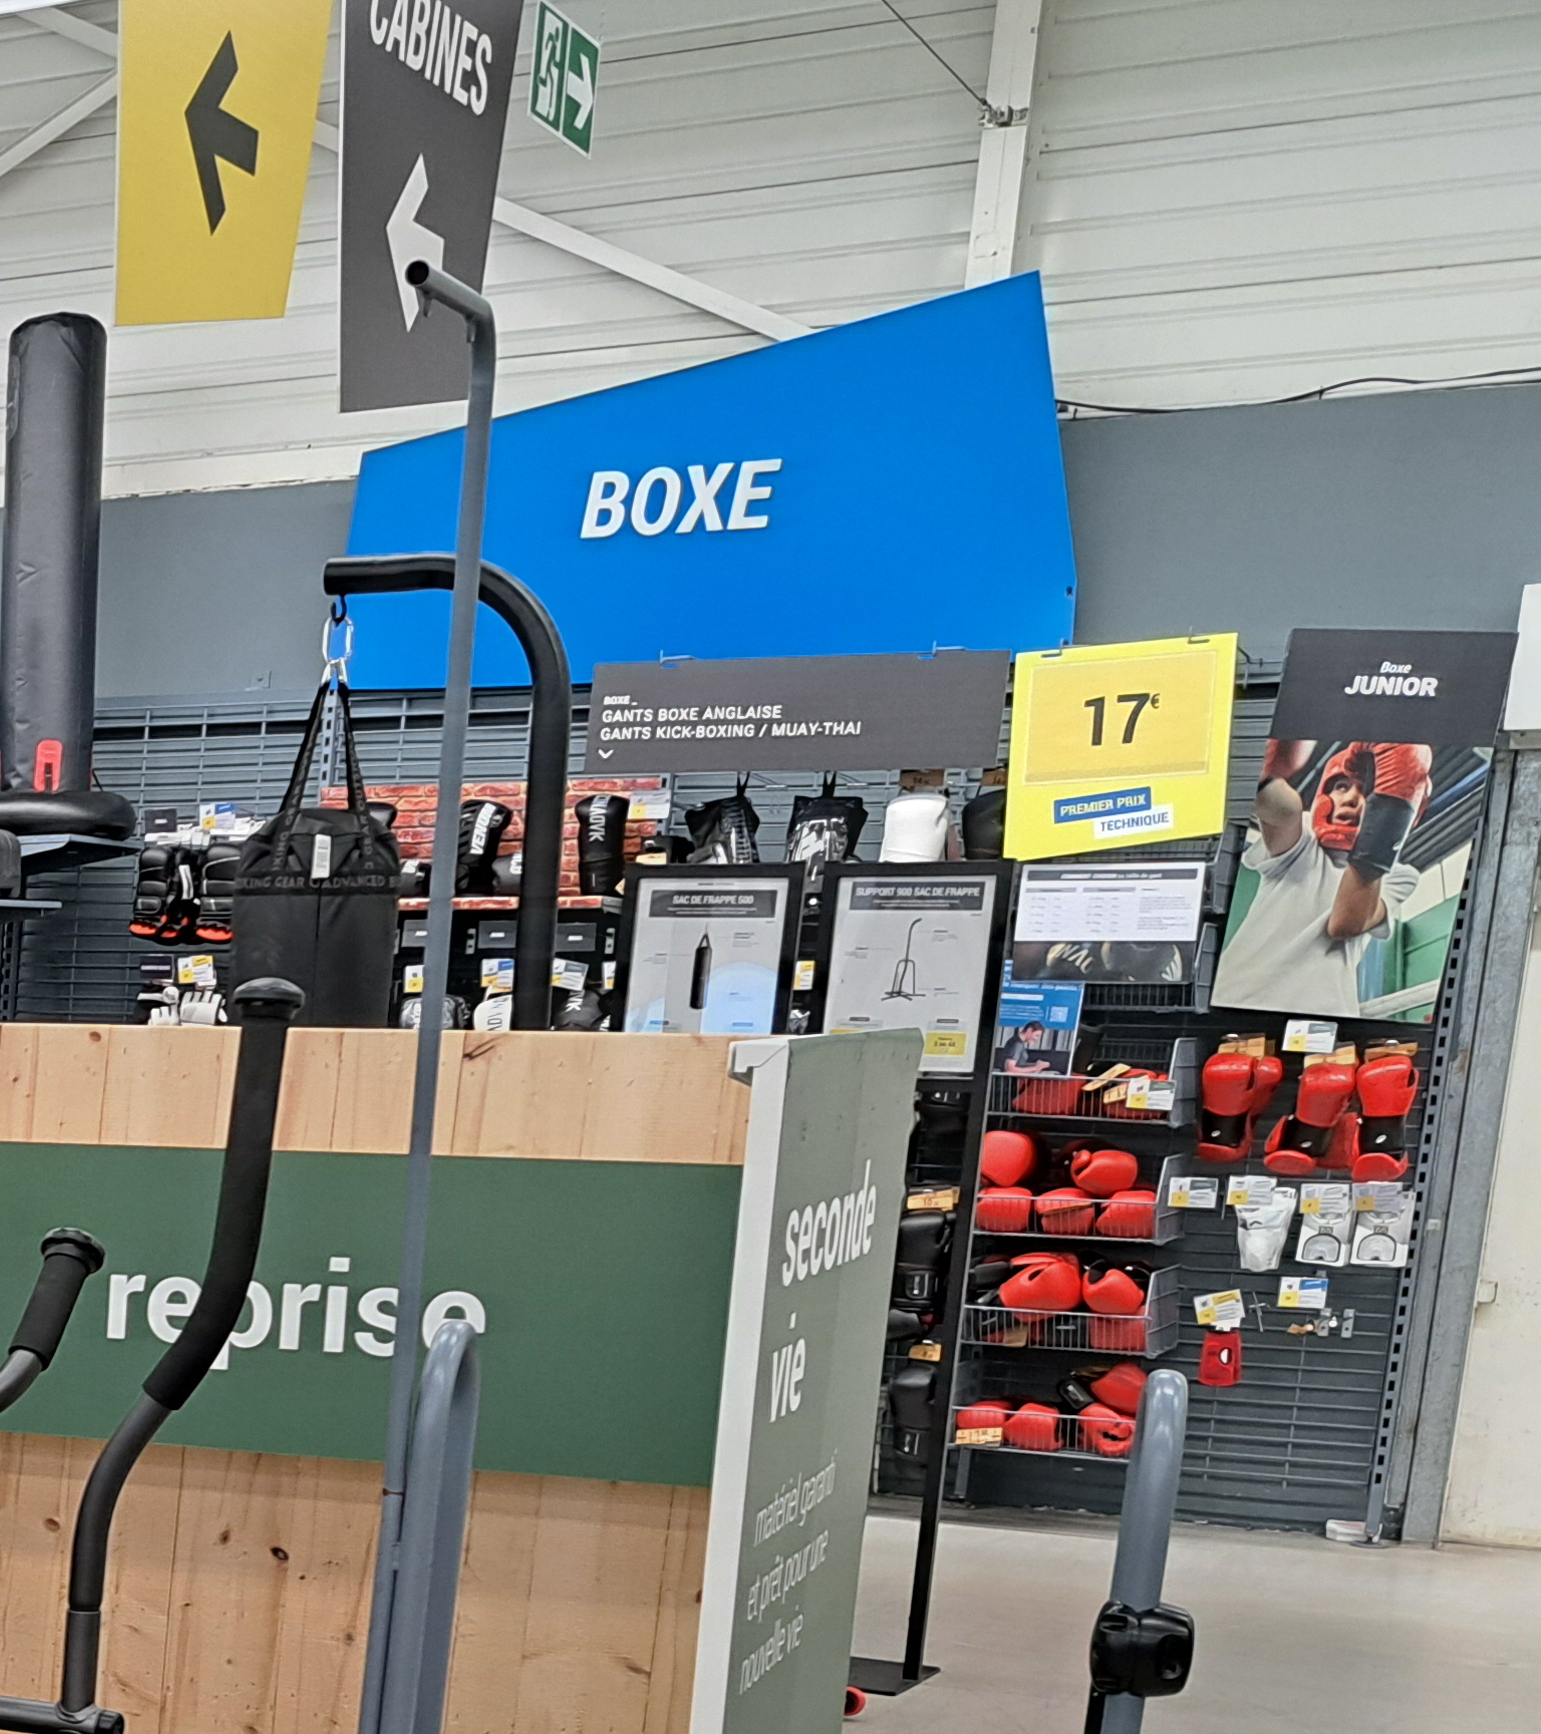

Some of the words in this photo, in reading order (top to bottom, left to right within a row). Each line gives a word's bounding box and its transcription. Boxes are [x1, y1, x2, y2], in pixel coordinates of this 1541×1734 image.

[370, 0, 492, 116] CABINES
[580, 458, 782, 539] BOXE
[1380, 660, 1412, 674] Boxe
[1344, 675, 1438, 697] JUNIOR
[603, 695, 630, 705] BOXE
[602, 709, 653, 723] GANTS
[658, 708, 699, 721] BOXE
[702, 705, 782, 720] ANGLAISE
[600, 726, 650, 740] GANTS
[655, 724, 755, 739] KICK-BOXING
[771, 721, 861, 737] MUAY-THAI
[1060, 799, 1114, 816] PREMIER
[1116, 793, 1146, 808] PRIX
[1099, 811, 1169, 832] TECHNIQUE
[274, 876, 305, 888] GEAR
[855, 886, 896, 897] SUPPORT
[913, 886, 931, 897] SAC
[931, 887, 944, 896] DE
[944, 886, 980, 897] FRAPPE
[672, 894, 689, 905] SAC
[690, 894, 702, 905] DE
[702, 894, 737, 905] FRAPPE
[782, 1159, 877, 1287] seconde
[106, 1257, 486, 1371] reprise
[770, 1312, 806, 1424] vie
[754, 1471, 803, 1547] matériel
[746, 1574, 761, 1621] et
[758, 1555, 784, 1624] prêt
[782, 1545, 809, 1604] pour
[809, 1529, 830, 1573] une
[738, 1617, 785, 1697] nouvelle
[786, 1604, 804, 1655] vie
